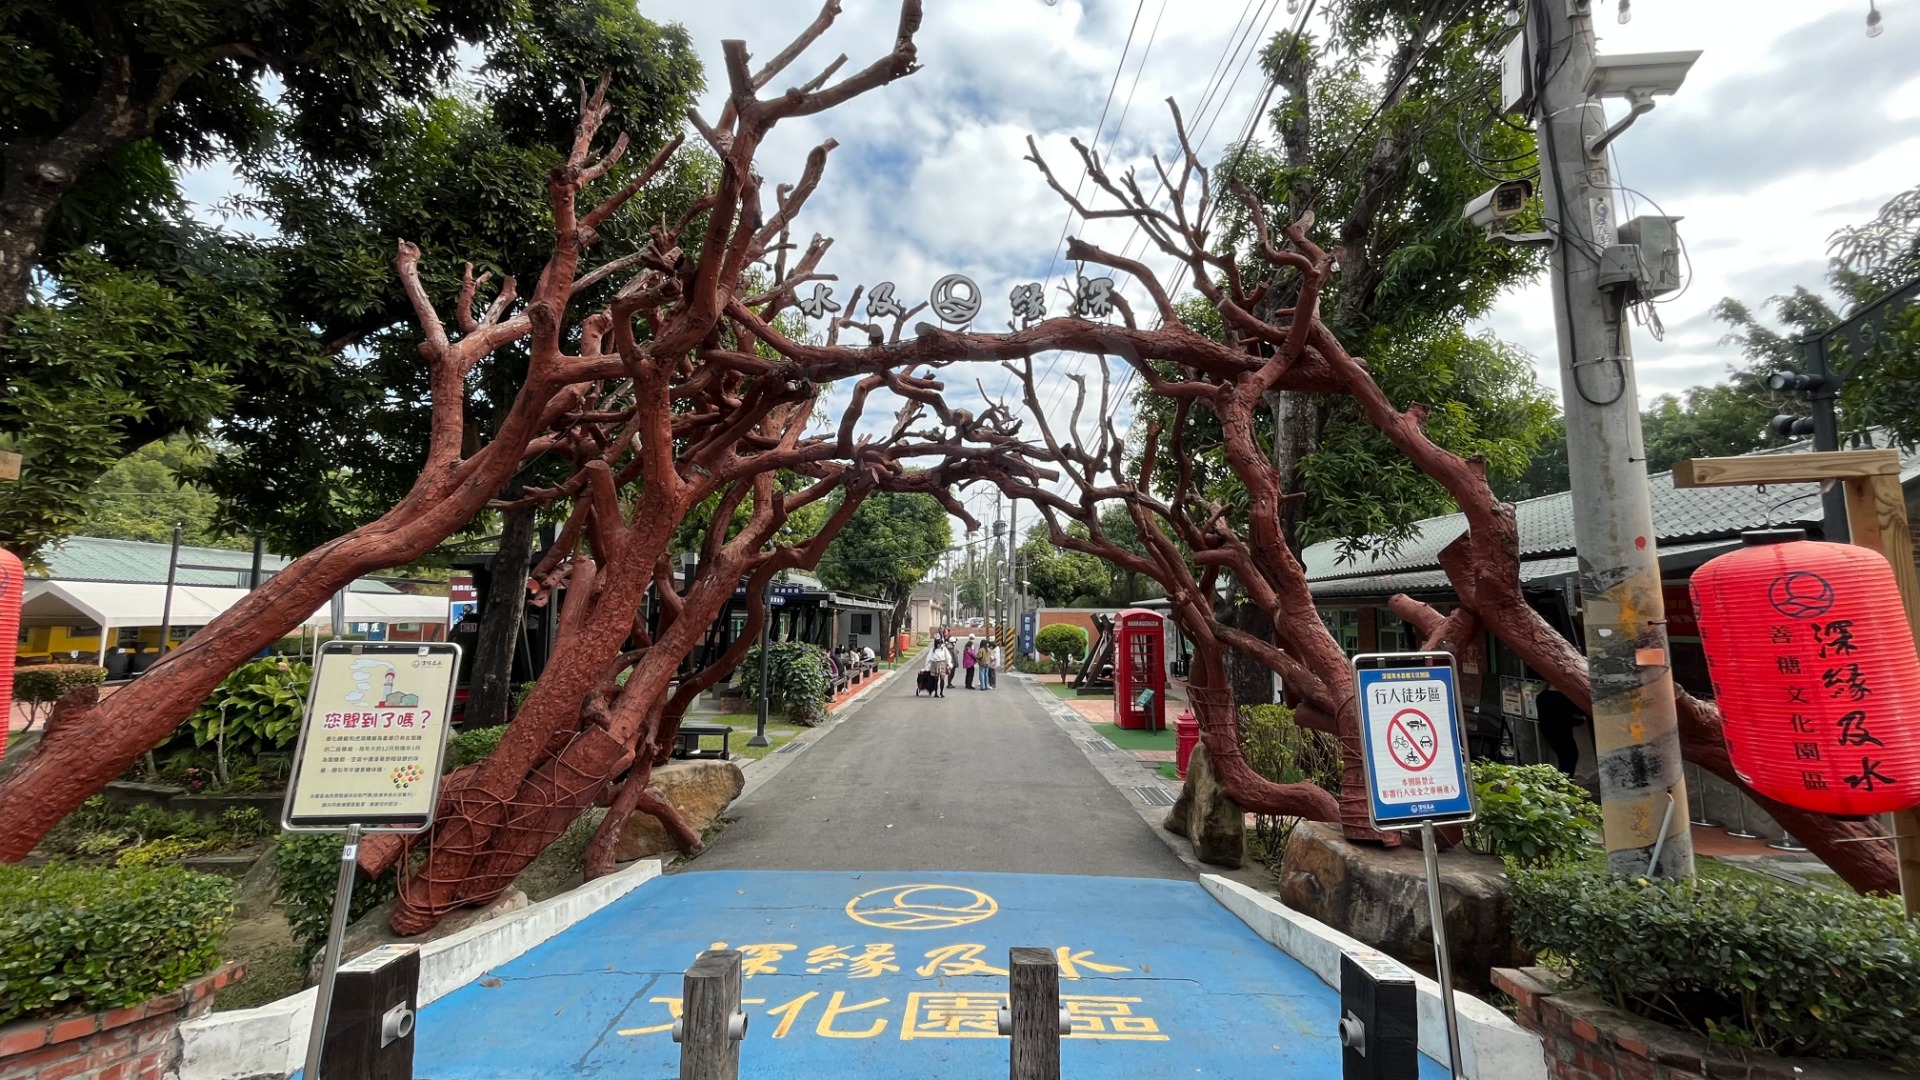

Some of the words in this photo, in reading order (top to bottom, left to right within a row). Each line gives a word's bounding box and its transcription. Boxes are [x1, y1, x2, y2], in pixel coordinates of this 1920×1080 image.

[1375, 687, 1441, 705] 行人徒步區
[1769, 624, 1830, 791] 善糖文化園區
[1811, 619, 1898, 792] 深緣及水
